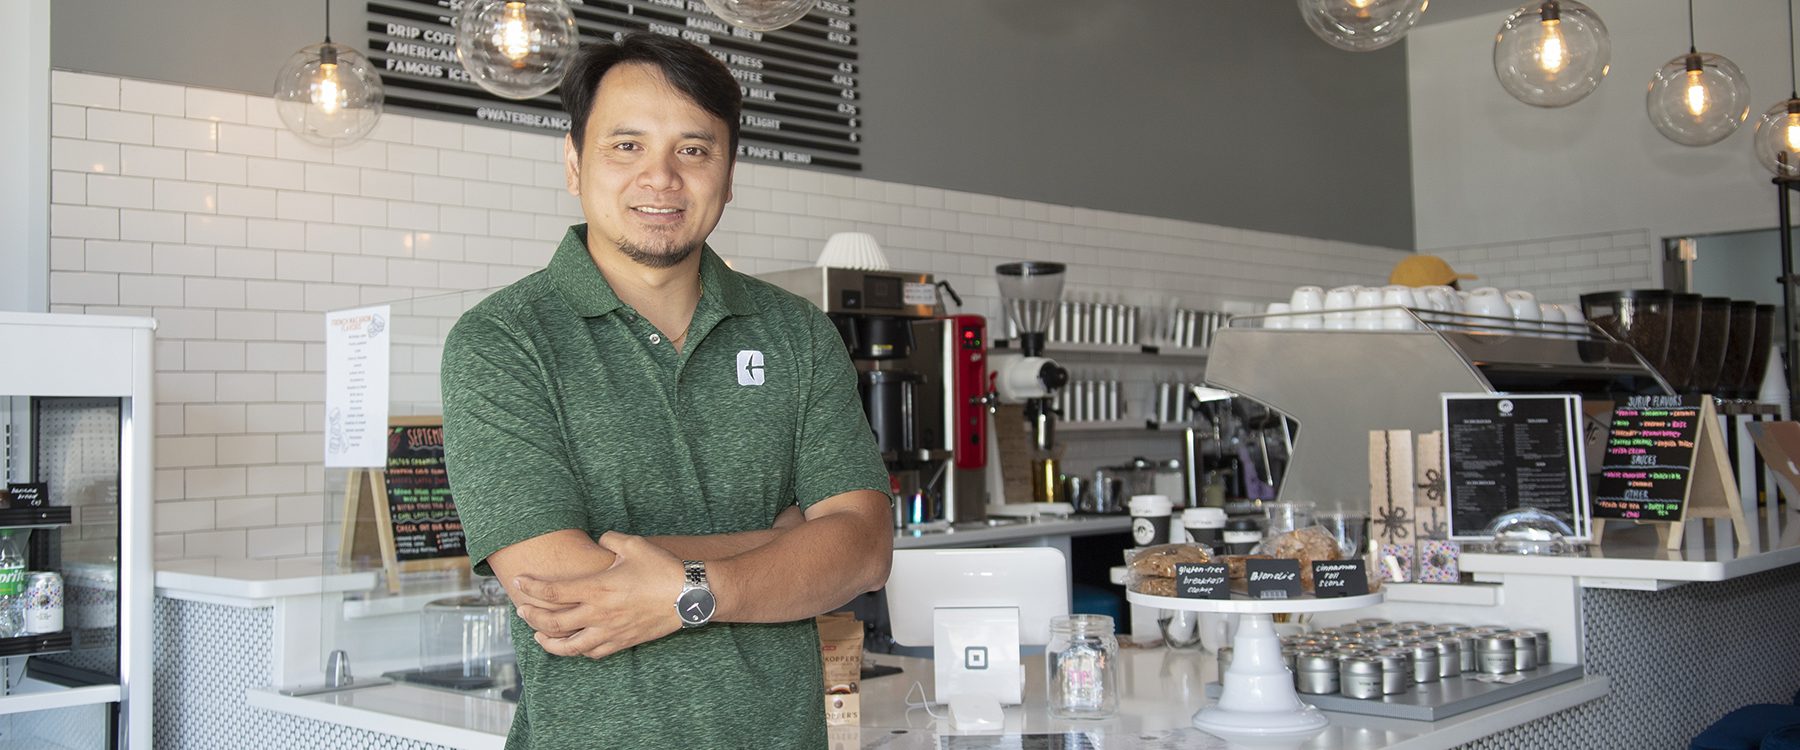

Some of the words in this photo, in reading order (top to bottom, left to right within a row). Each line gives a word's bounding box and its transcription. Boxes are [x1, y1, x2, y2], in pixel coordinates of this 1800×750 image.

[386, 23, 420, 39] DRIP
[423, 30, 457, 46] COFF
[649, 23, 680, 37] POUR
[681, 30, 711, 44] OVER
[686, 17, 730, 35] MANUAL
[732, 27, 763, 41] BREW
[386, 41, 459, 63] AMERICAN
[730, 54, 763, 69] PRESS
[386, 59, 443, 77] FAMOUS
[448, 68, 472, 81] ICE
[727, 67, 763, 83] OFFEE
[749, 88, 776, 101] MILK
[745, 115, 780, 129] FLIGHT
[747, 146, 780, 160] PAPER
[782, 151, 812, 164] MENU
[1653, 395, 1682, 406] FLAVORS
[407, 426, 444, 448] SEPTEM
[1631, 455, 1657, 465] SAUCES
[1624, 490, 1648, 500] OTHER
[1178, 565, 1225, 576] gluten-free
[1315, 563, 1358, 572] cinnamon
[1183, 576, 1225, 585] breakfast
[1250, 571, 1296, 581] Blondie
[825, 711, 858, 720] OPPER'S
